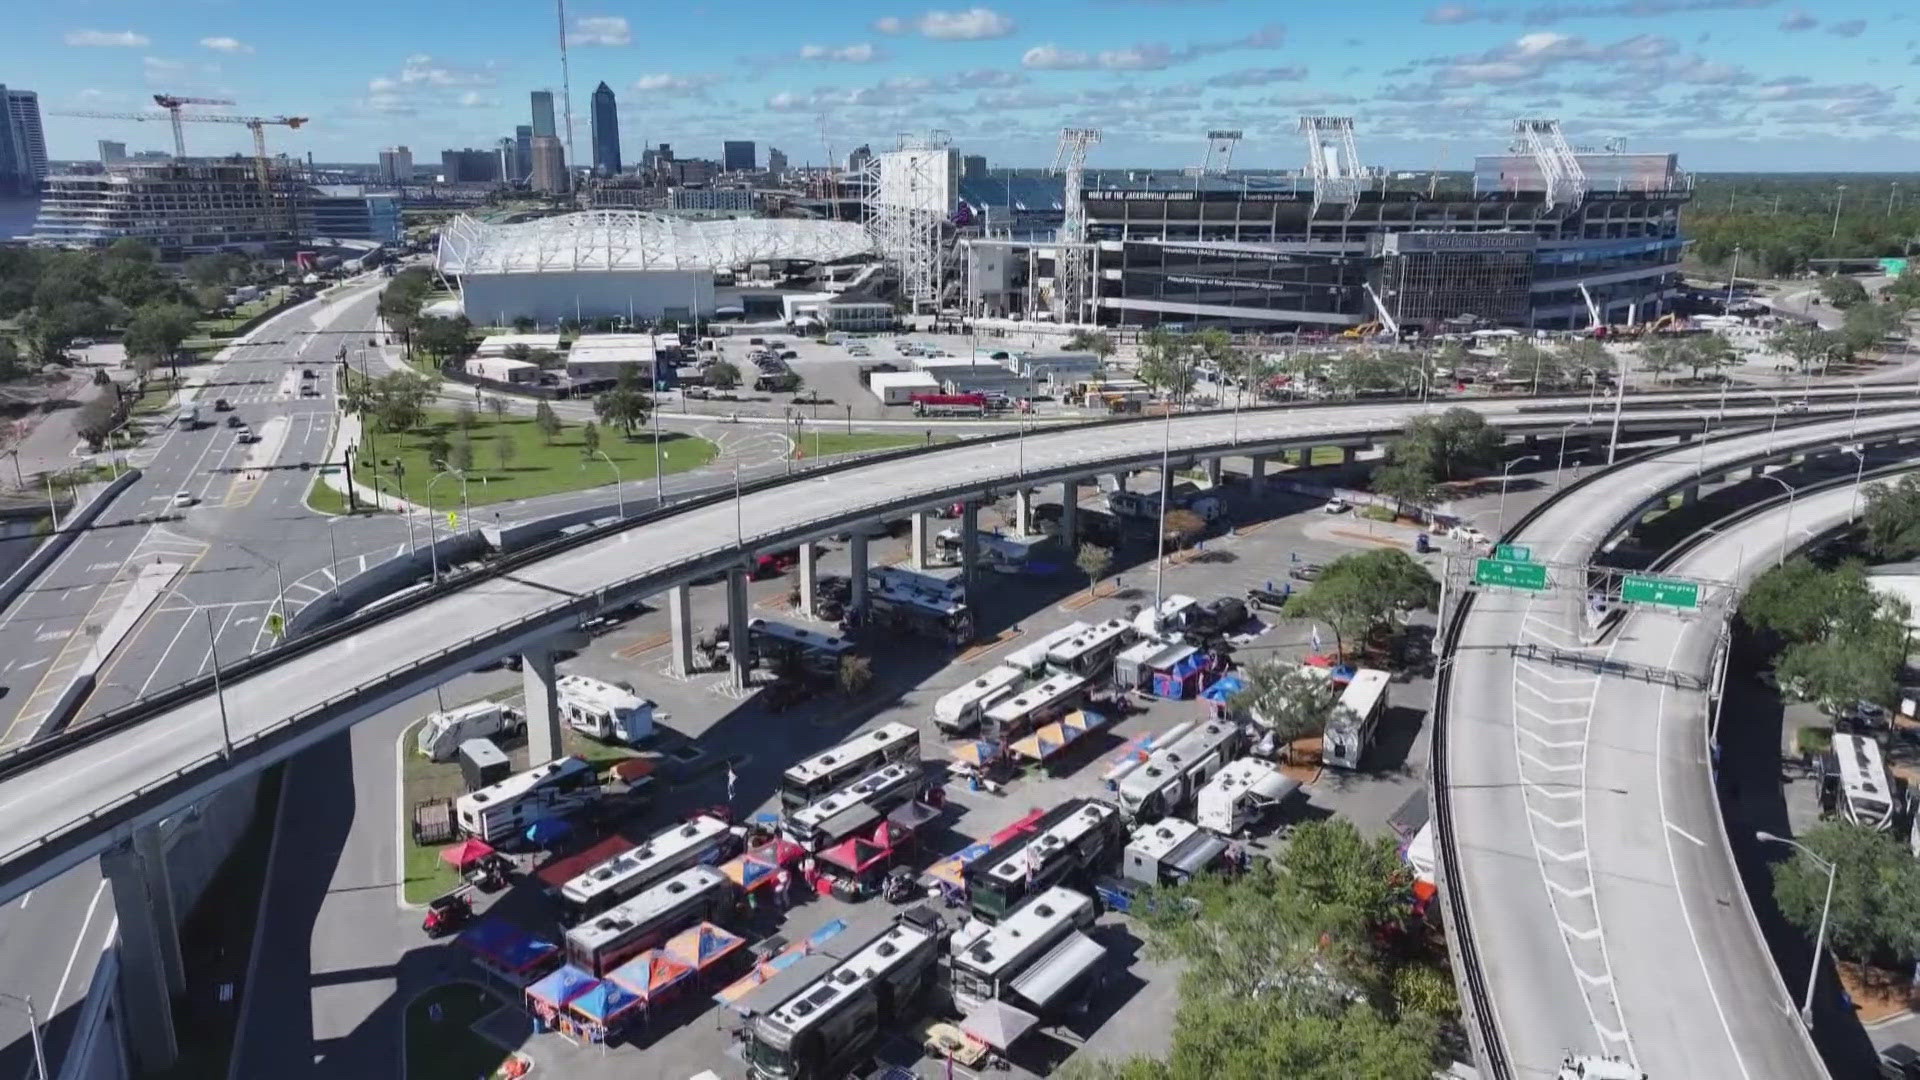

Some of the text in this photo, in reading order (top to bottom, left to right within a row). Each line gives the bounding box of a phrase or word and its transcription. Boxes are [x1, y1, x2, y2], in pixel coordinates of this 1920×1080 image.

[1113, 191, 1124, 200] THE
[1426, 235, 1525, 248] EverBank Stadium
[1658, 582, 1696, 594] Complex
